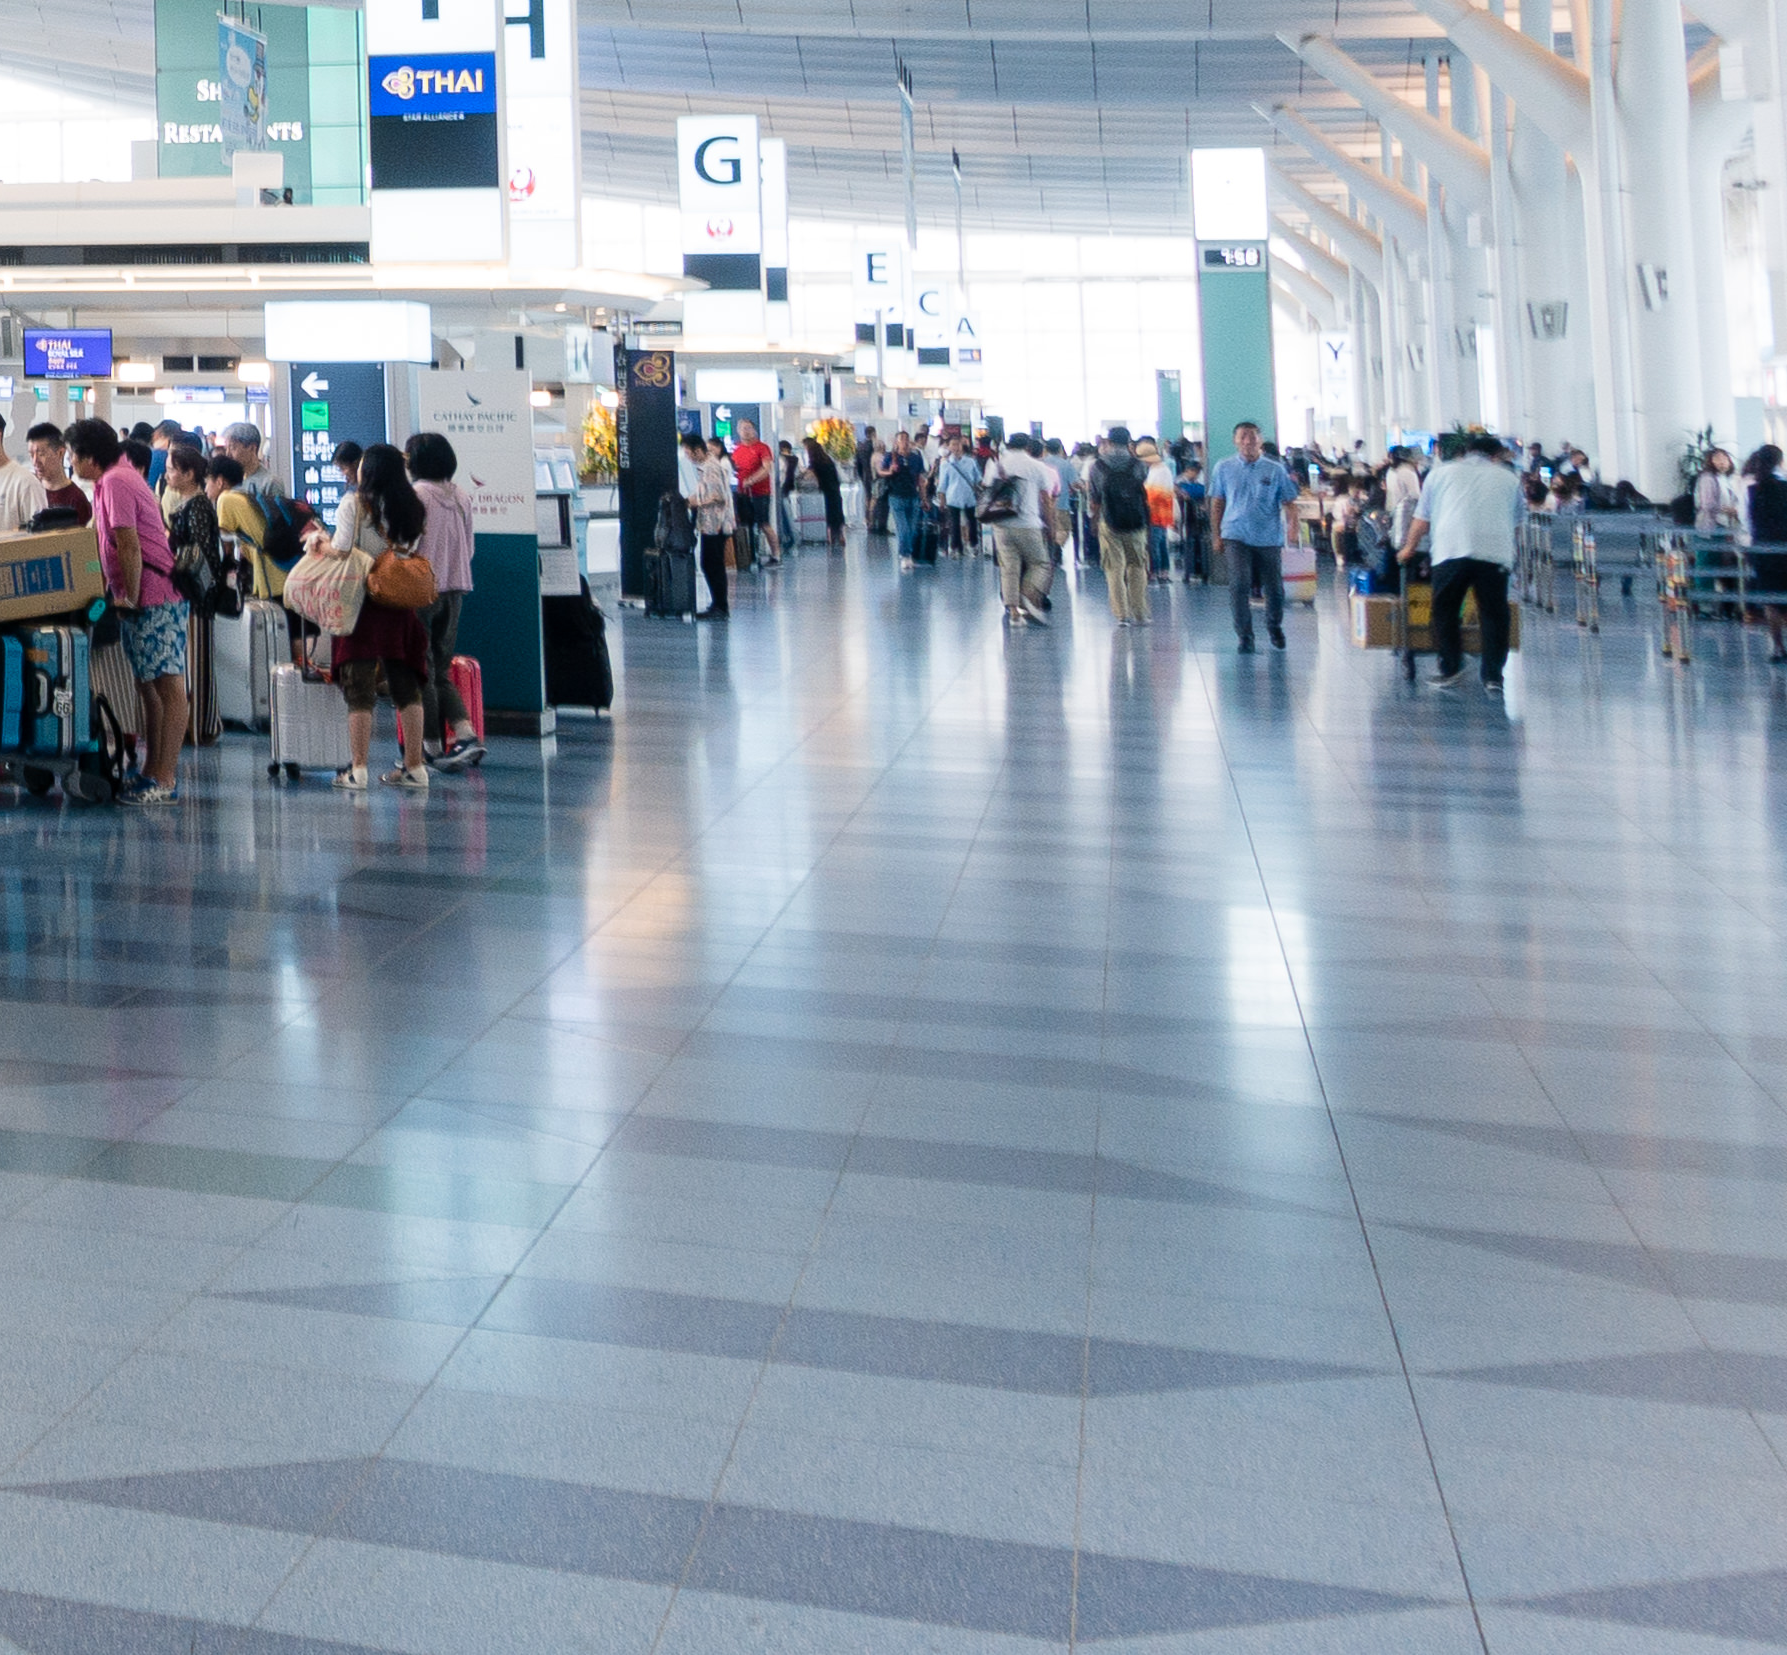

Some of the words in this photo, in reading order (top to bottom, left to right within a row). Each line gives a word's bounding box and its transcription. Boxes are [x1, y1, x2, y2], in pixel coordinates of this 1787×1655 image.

[416, 70, 483, 93] THAI
[694, 136, 742, 185] G
[867, 253, 887, 283] E
[919, 290, 939, 316] C
[957, 317, 975, 337] A
[47, 340, 72, 350] THAI
[433, 410, 474, 422] CATHAY
[477, 411, 518, 422] PACIFIC
